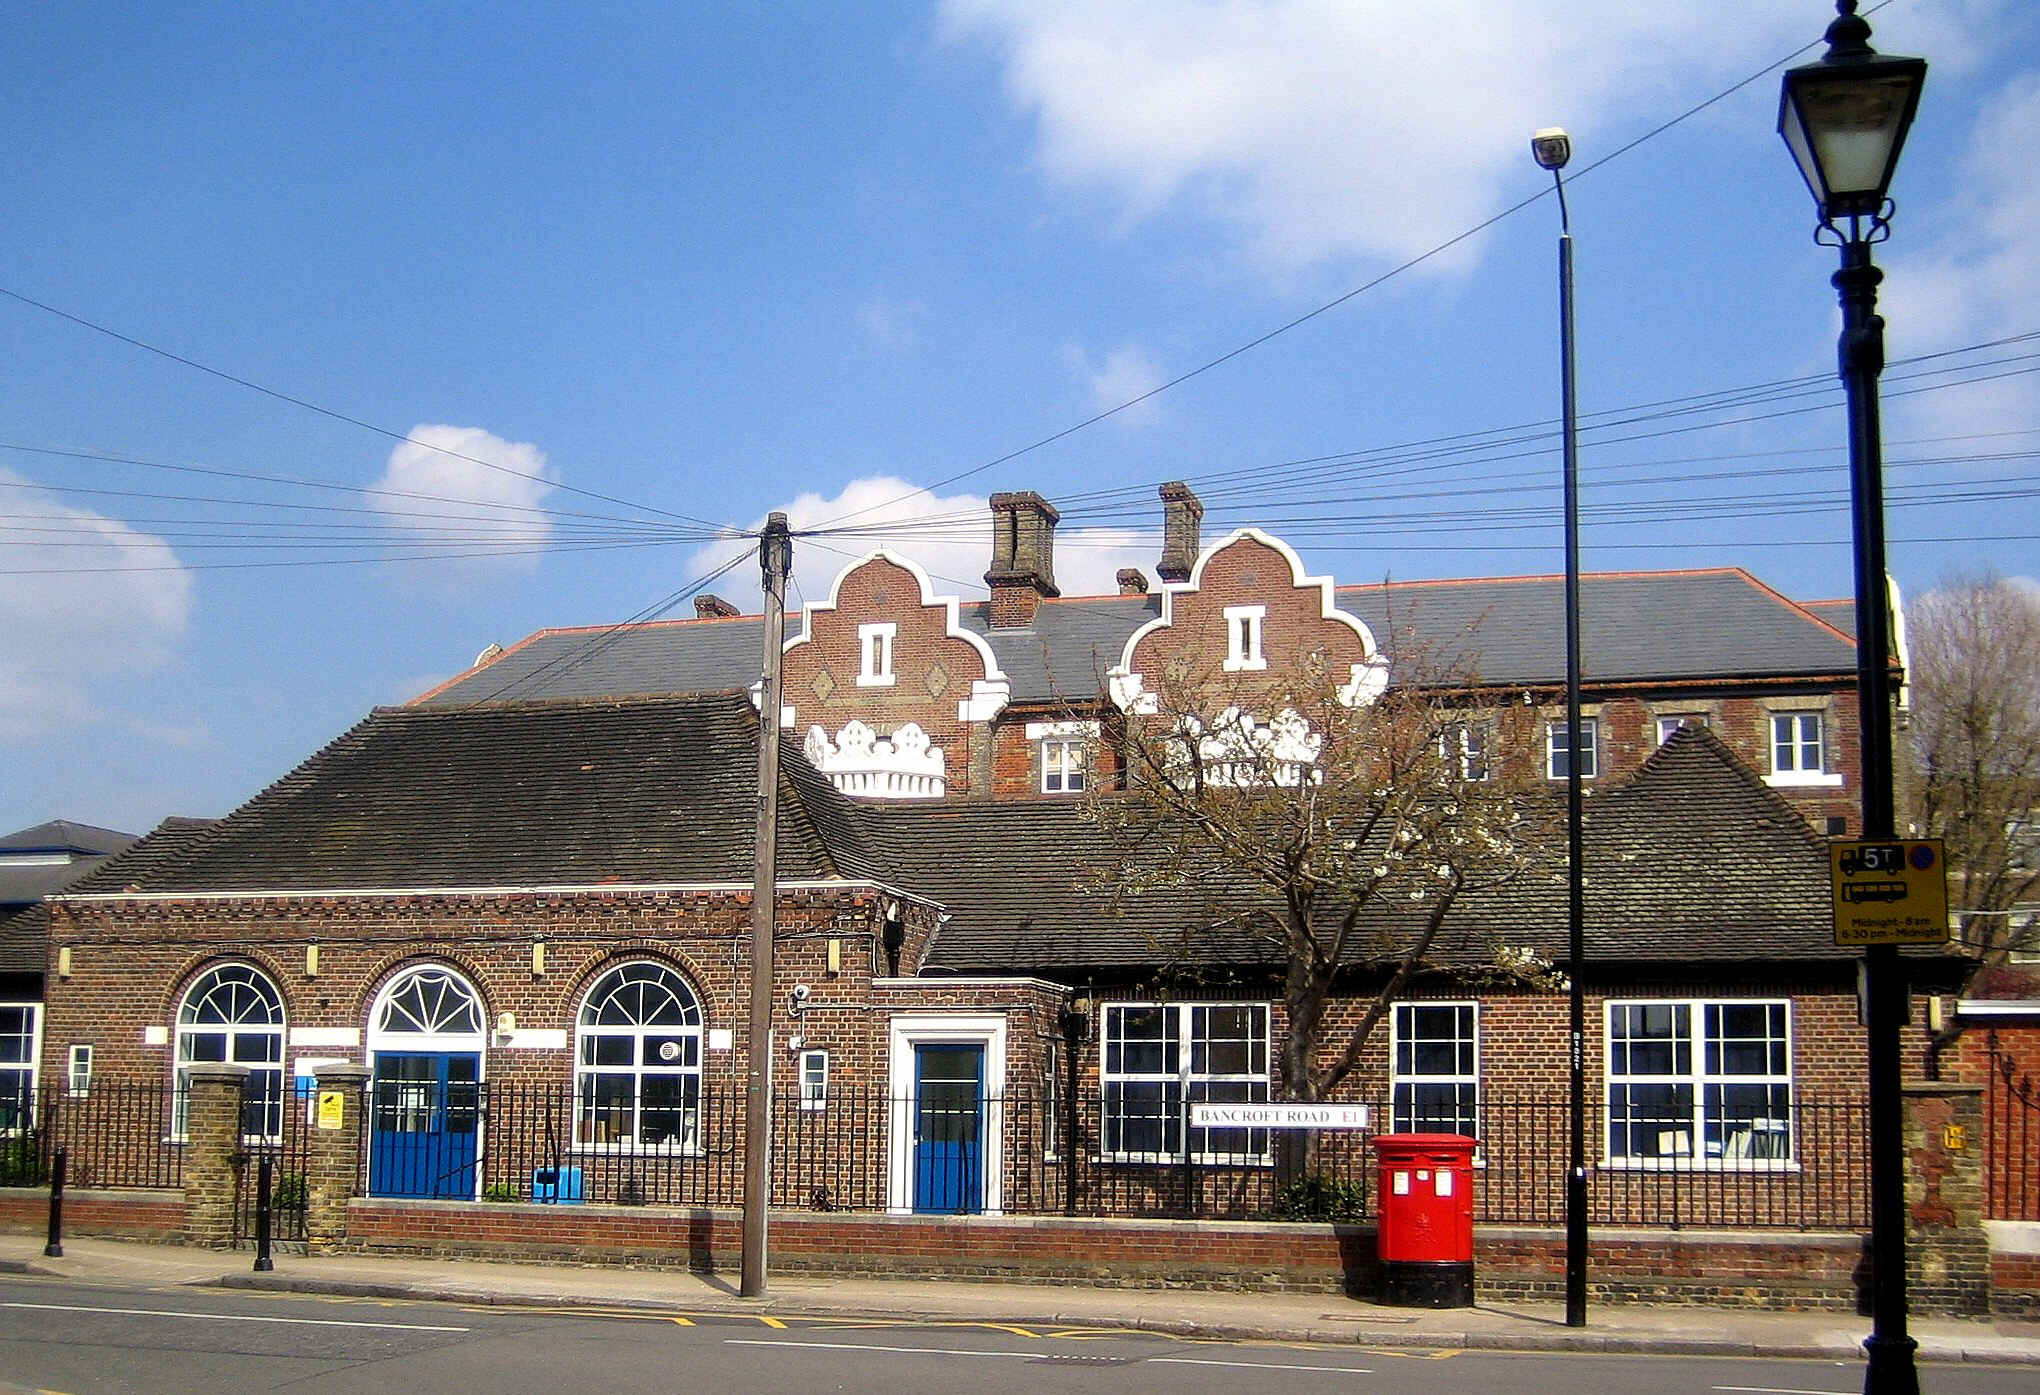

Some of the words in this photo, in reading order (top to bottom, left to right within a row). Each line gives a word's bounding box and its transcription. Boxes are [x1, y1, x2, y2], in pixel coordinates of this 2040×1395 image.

[1851, 917, 1899, 928] Midnight
[1896, 927, 1942, 938] Midnight
[1201, 1109, 1280, 1122] BANCROFT
[1287, 1110, 1330, 1123] ROAD
[1343, 1111, 1358, 1123] E1
